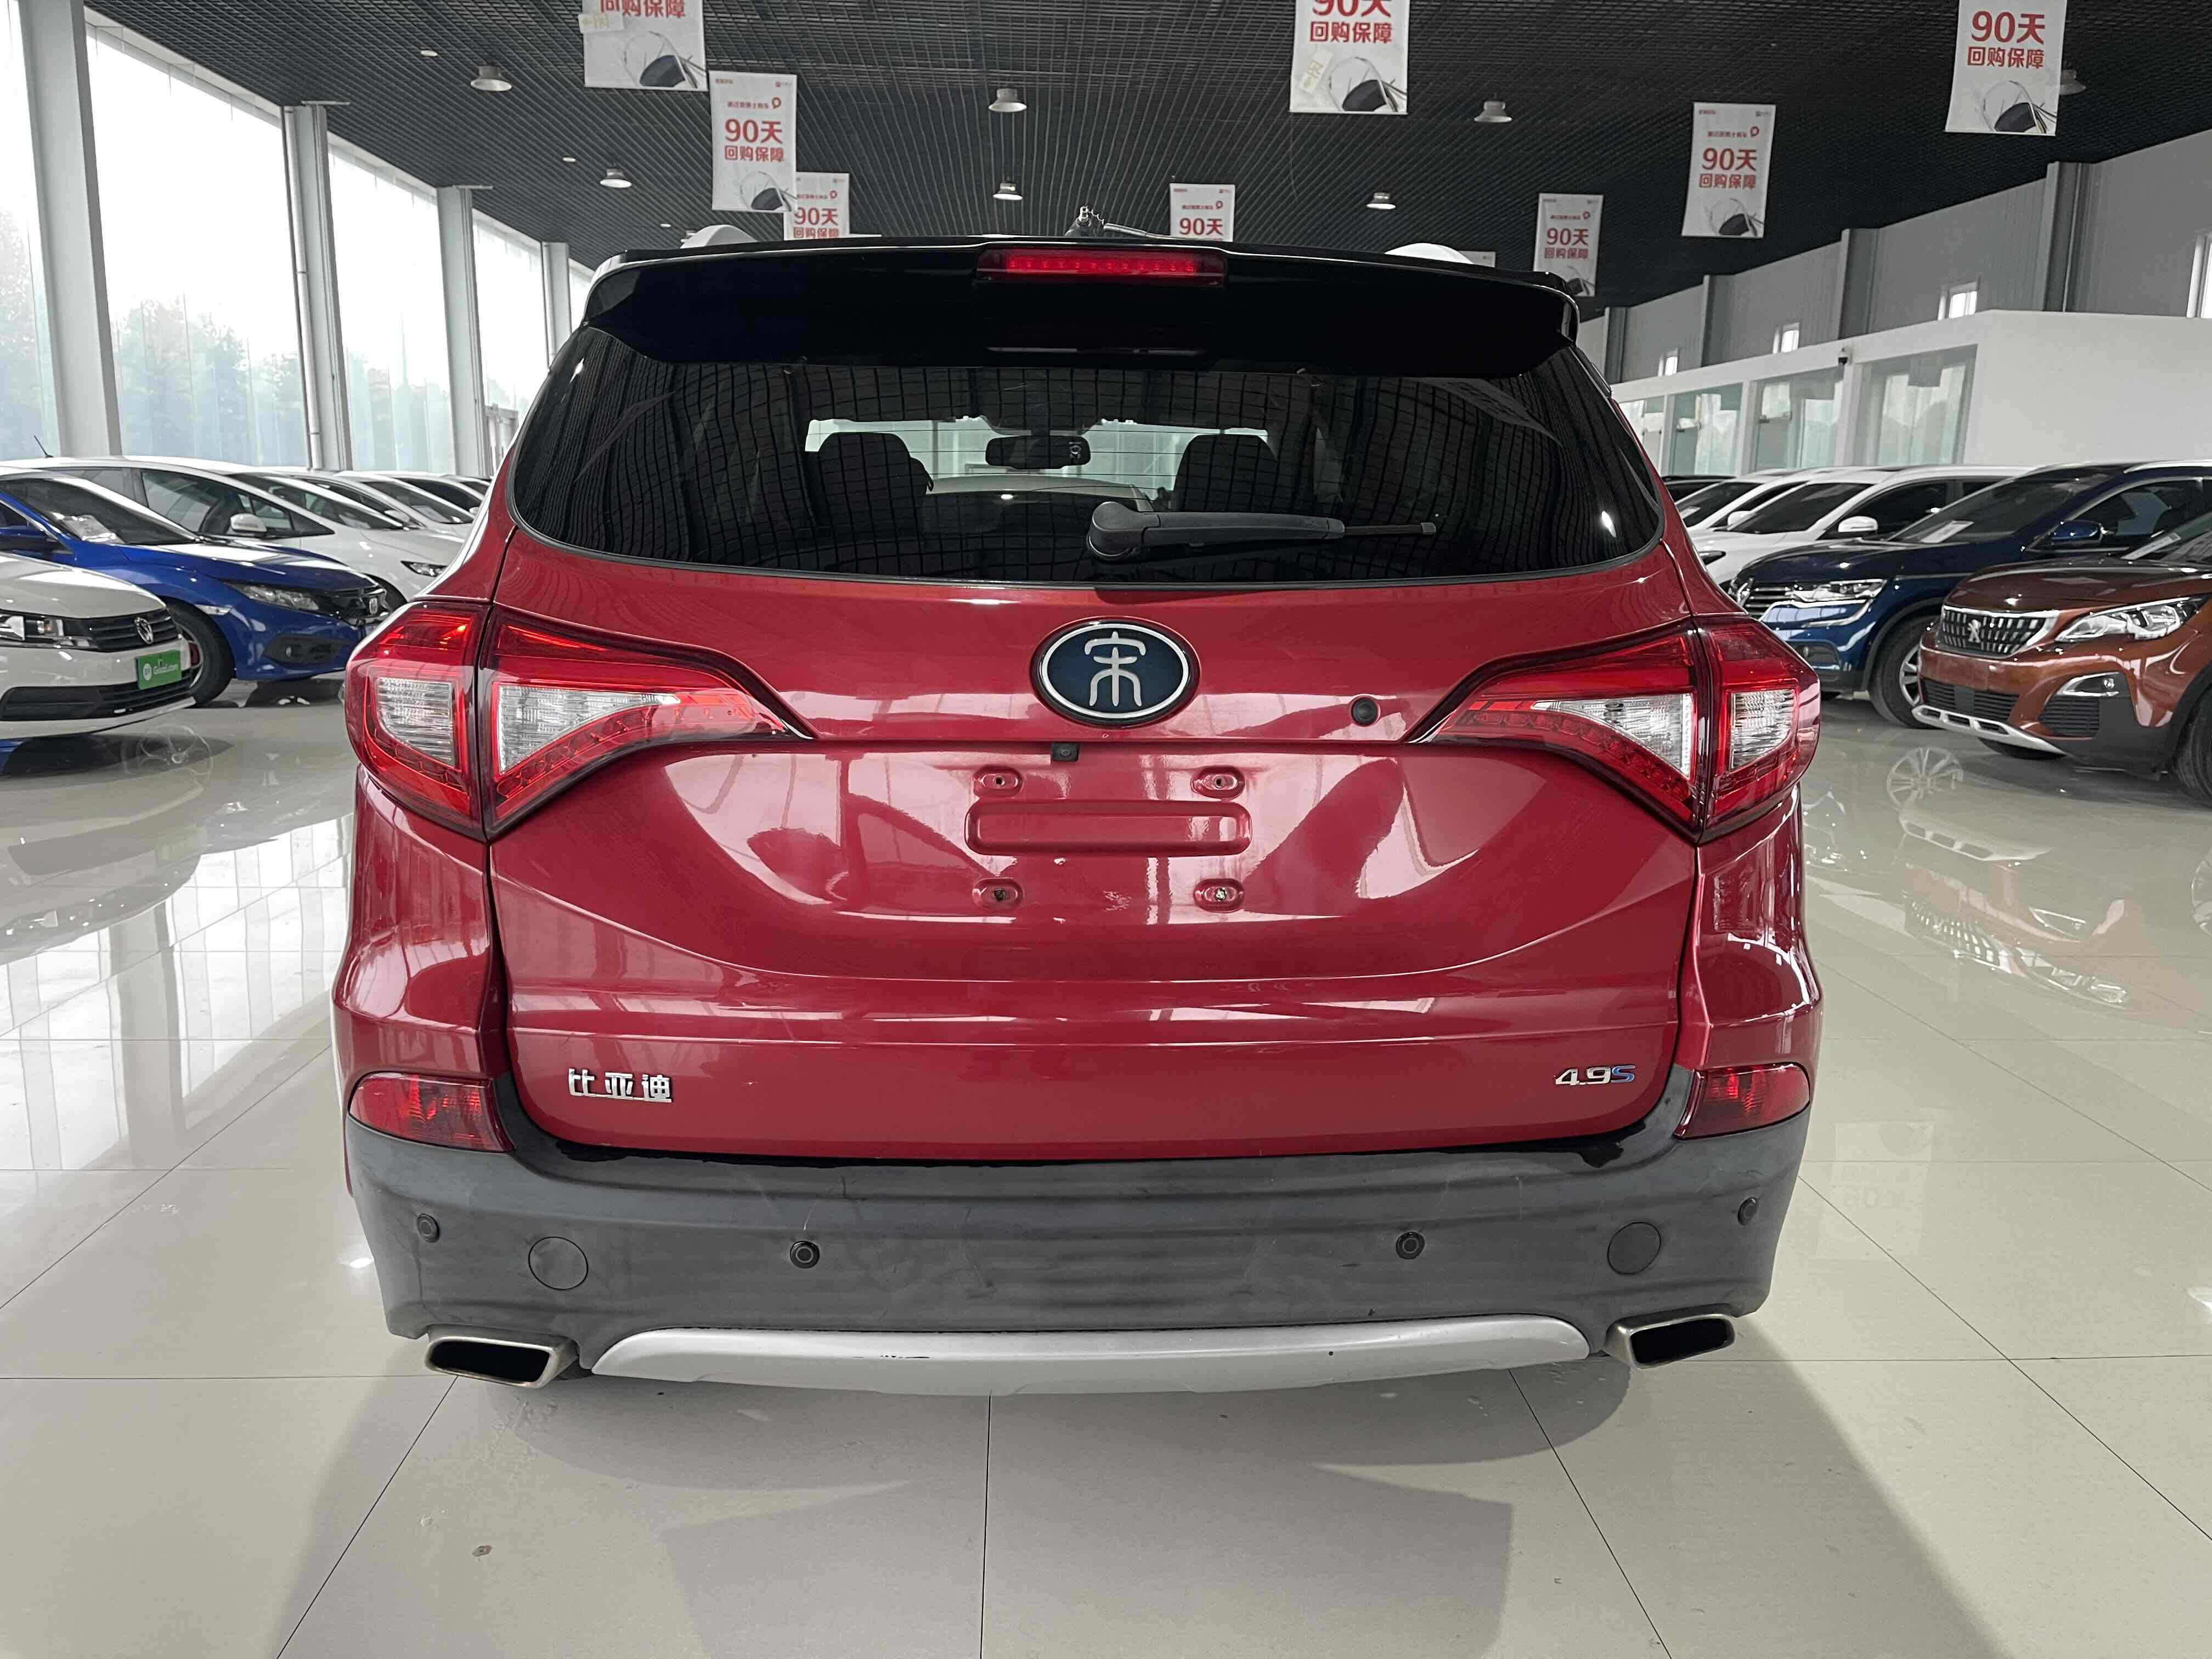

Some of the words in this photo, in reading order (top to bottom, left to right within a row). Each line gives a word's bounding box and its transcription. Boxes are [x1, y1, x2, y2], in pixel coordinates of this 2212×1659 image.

[1310, 21, 1392, 43] 回购保障
[1971, 10, 2045, 45] 90天
[1967, 46, 2045, 69] 回购保障
[725, 119, 782, 144] 90天
[724, 145, 784, 162] 回购保障
[1702, 148, 1757, 171] 90天
[1699, 173, 1756, 189] 回购保障
[794, 207, 838, 225] 90天
[1180, 218, 1223, 235] 90天
[1547, 228, 1589, 246] 90天
[568, 1068, 672, 1103] 比亚迪
[1554, 1065, 1635, 1086] 4.9S
